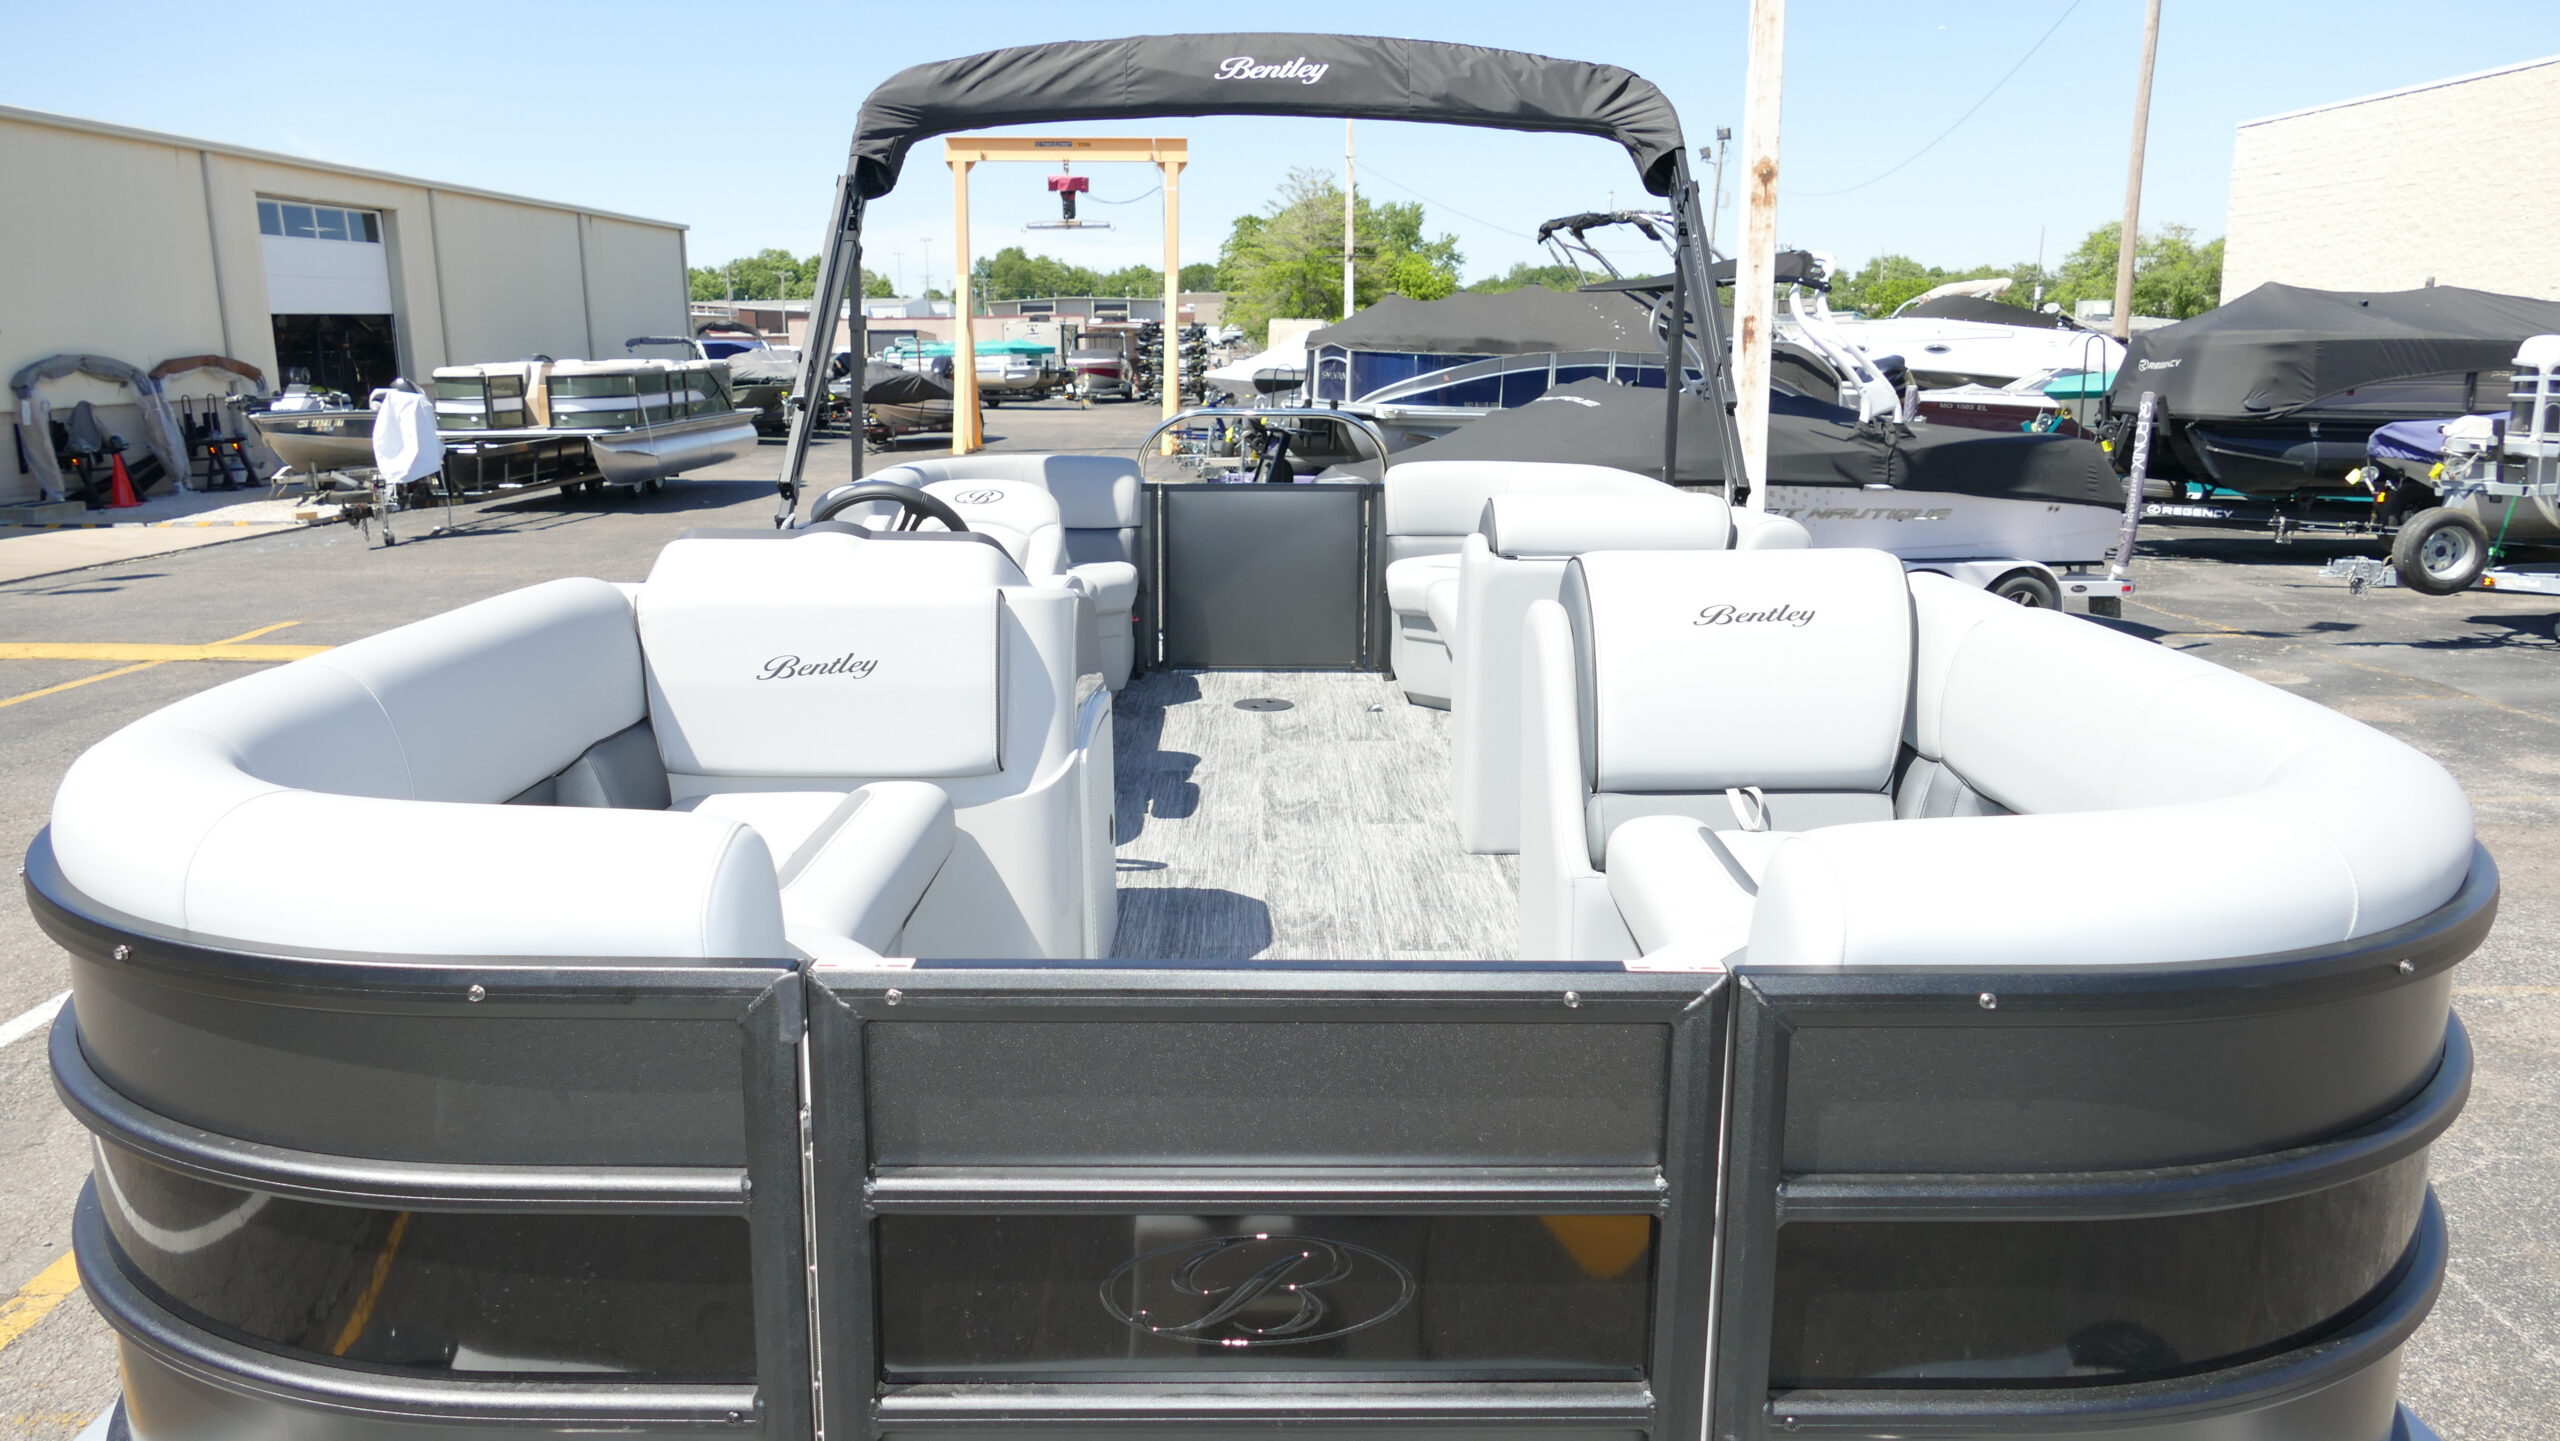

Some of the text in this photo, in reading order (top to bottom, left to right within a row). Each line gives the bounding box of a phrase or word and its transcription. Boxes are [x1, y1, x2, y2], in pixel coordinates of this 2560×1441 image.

[1214, 56, 1330, 85] Bentley
[2131, 421, 2150, 470] RONIX
[2126, 472, 2138, 523] WAKEBOARDS
[2161, 506, 2234, 518] REGENCY
[1807, 508, 1952, 520] NAUTIQUE
[1693, 604, 1816, 628] Bentley
[756, 652, 879, 681] Bentley
